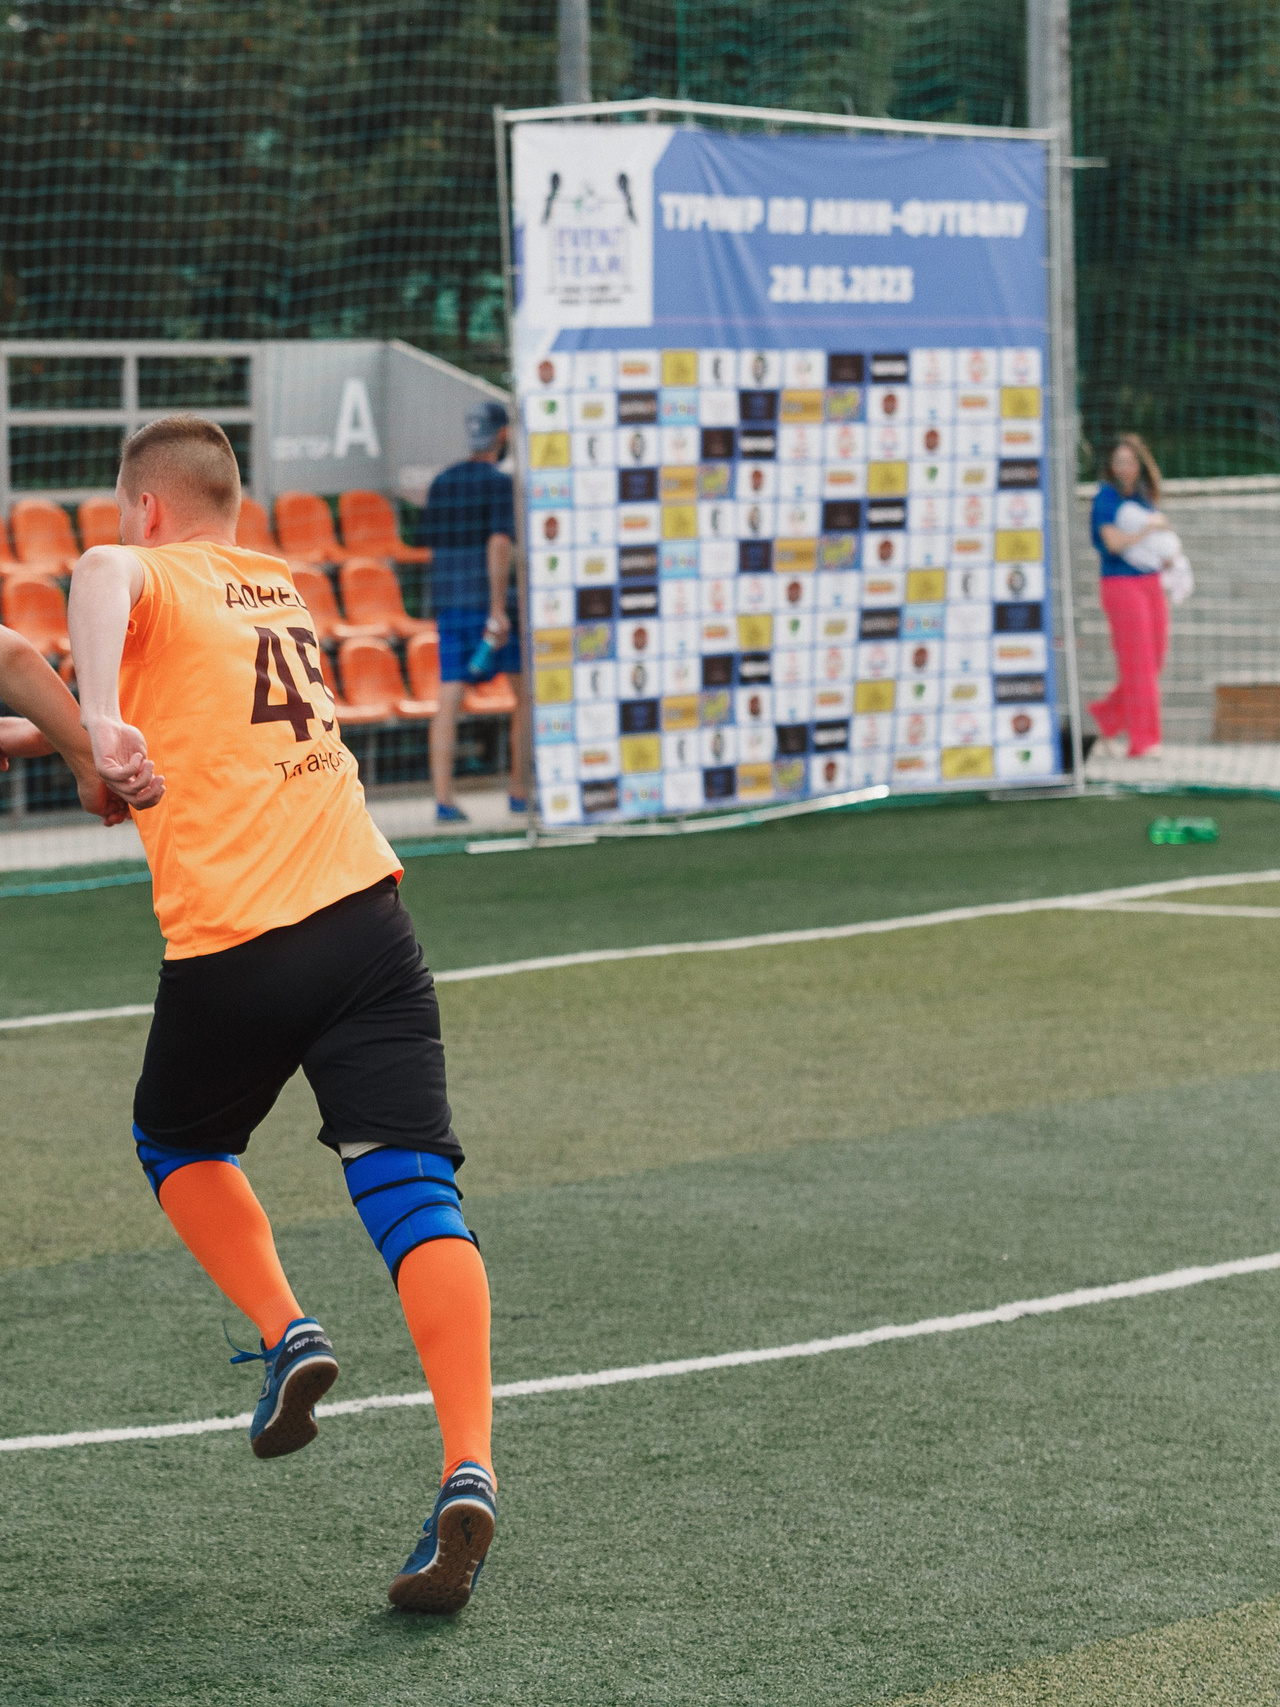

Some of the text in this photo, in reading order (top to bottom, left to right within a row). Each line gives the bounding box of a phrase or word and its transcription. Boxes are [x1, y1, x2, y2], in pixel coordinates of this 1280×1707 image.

[659, 192, 1028, 238] ТУРНИР ПО МИНИ-ФУТБОЛУ
[251, 626, 334, 742] 45
